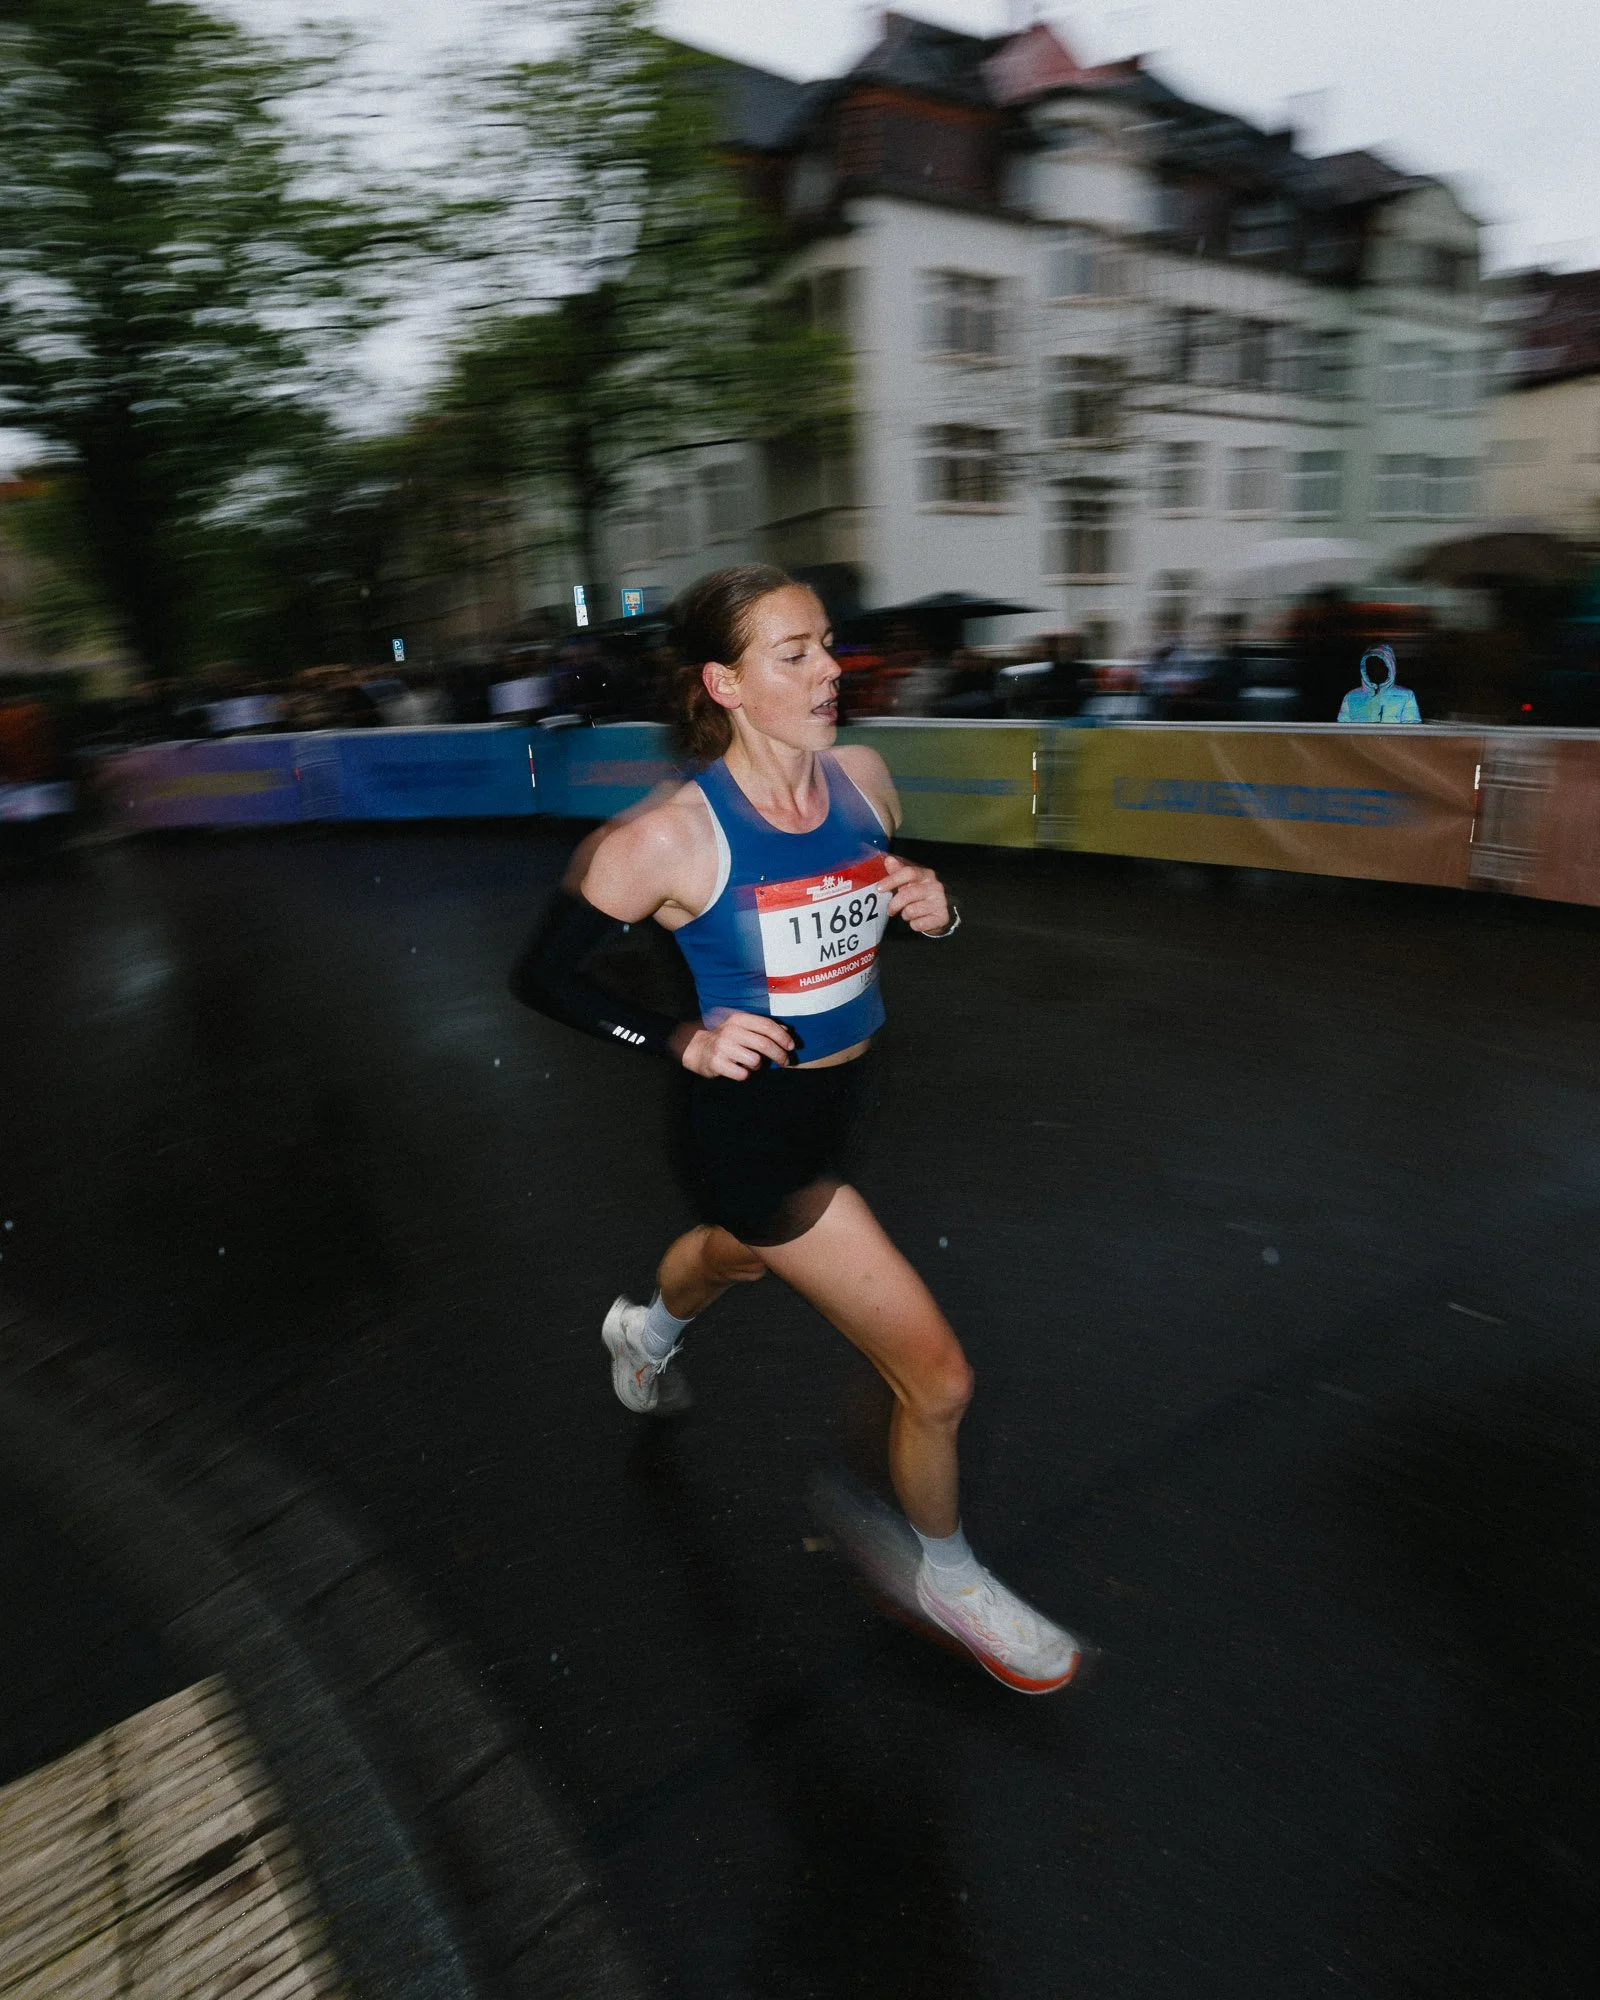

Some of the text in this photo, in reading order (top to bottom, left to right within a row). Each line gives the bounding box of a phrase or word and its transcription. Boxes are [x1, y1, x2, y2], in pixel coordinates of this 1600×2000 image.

[789, 893, 878, 944] 11682
[820, 934, 859, 962] MEG
[799, 959, 860, 987] HALBMARATHON
